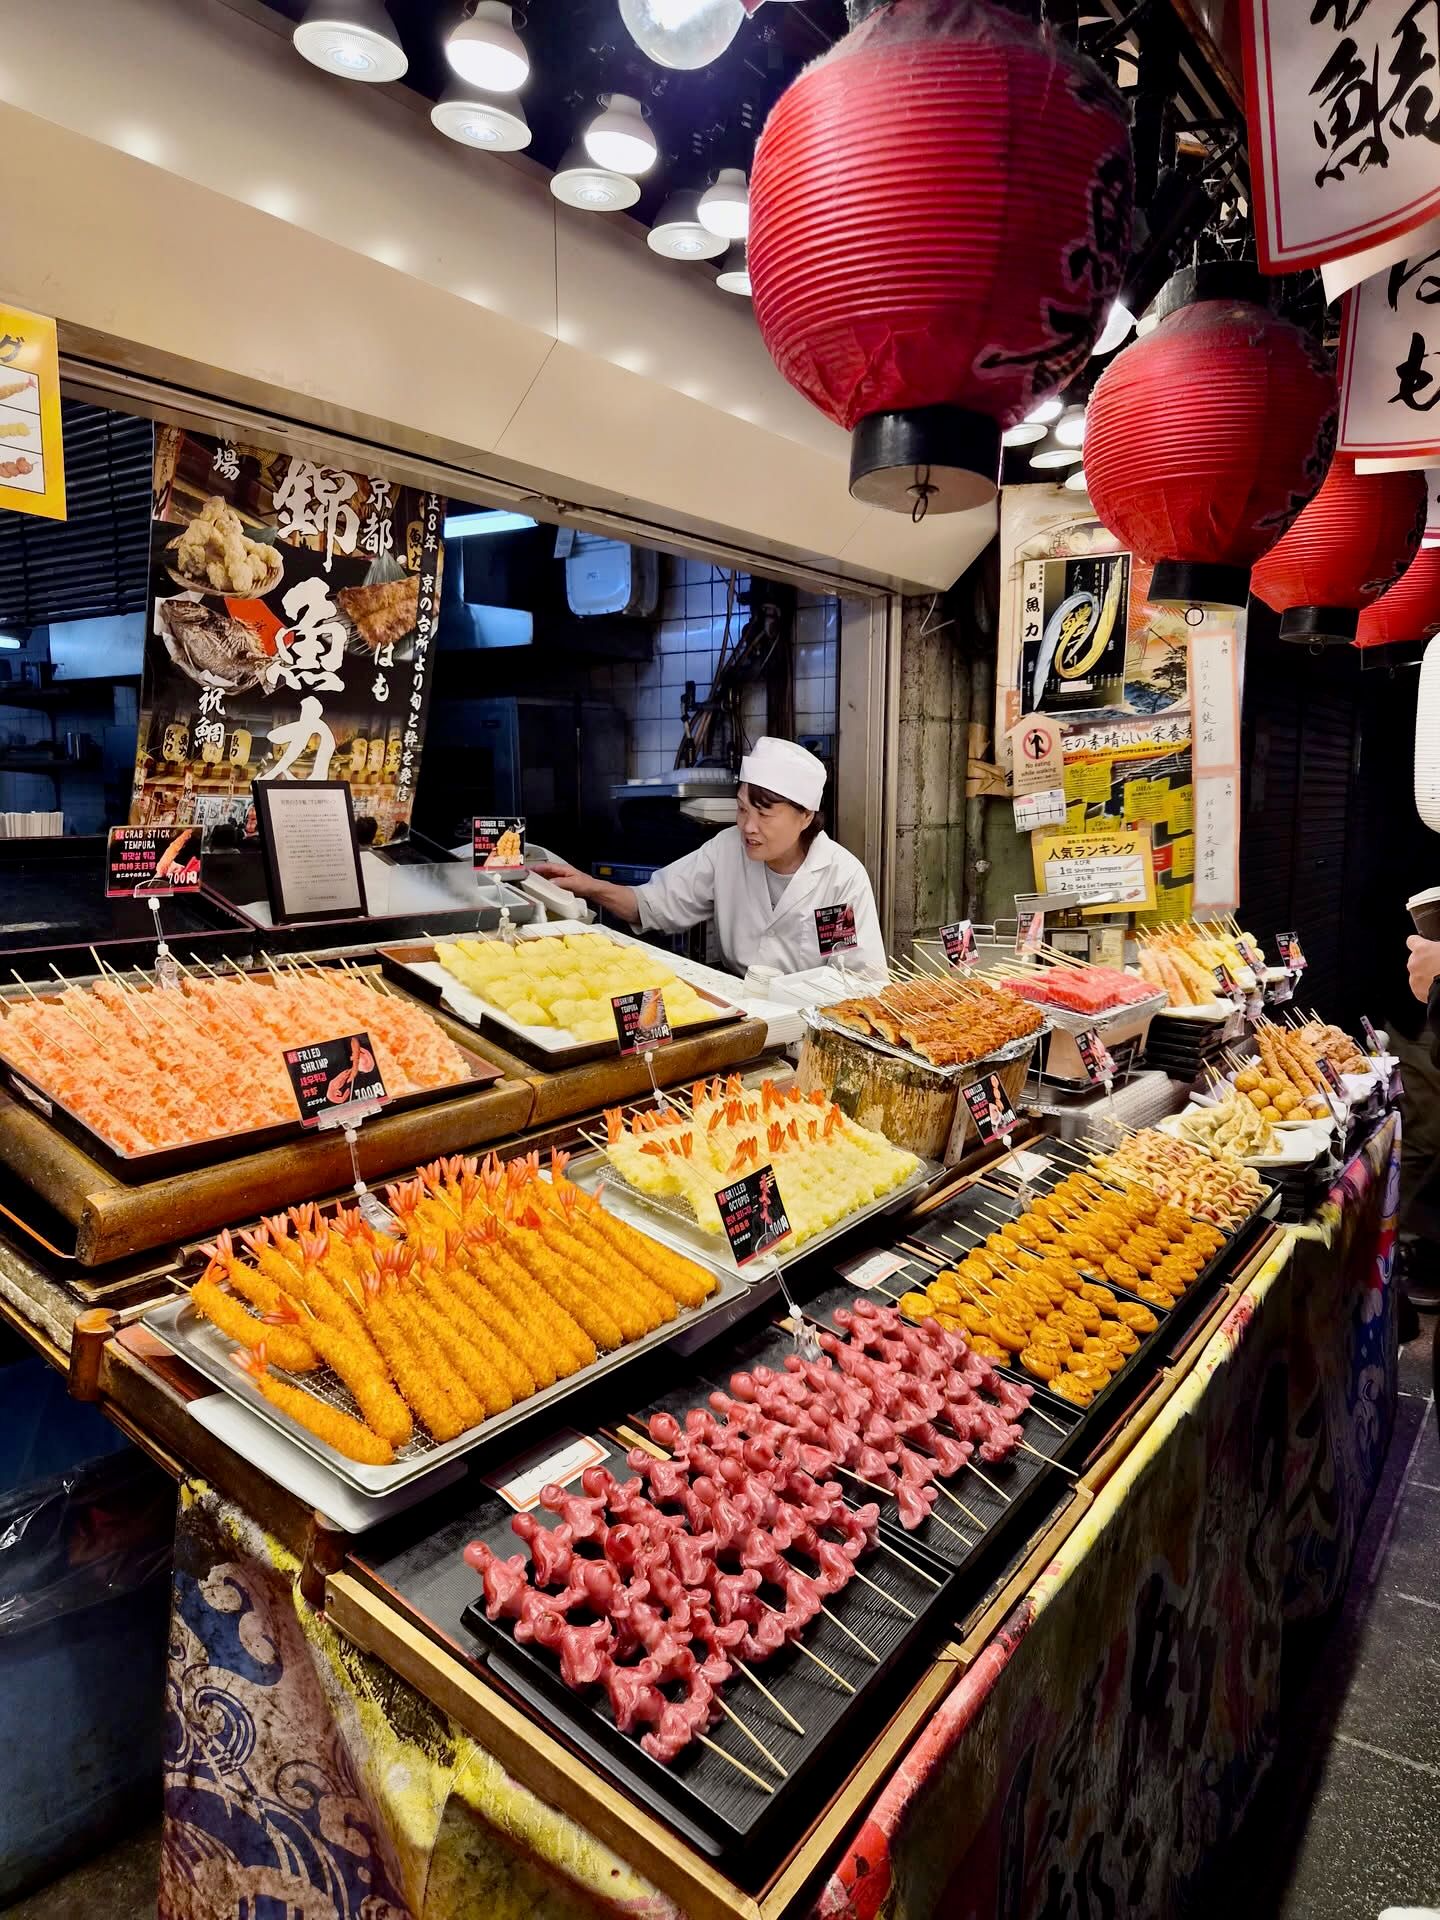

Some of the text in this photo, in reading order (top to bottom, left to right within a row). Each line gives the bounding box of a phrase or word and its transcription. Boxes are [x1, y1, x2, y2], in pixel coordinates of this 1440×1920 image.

[371, 642, 396, 702] はも
[193, 686, 226, 748] 祝鯛
[1021, 766, 1057, 777] while walking
[1035, 760, 1051, 768] eating
[124, 829, 144, 839] CRAB
[147, 829, 170, 839] STICK
[124, 840, 156, 850] TEMPURA
[1048, 841, 1137, 861] 人気ランキング
[1096, 865, 1122, 873] Tempura
[168, 871, 197, 884] 700円
[1095, 881, 1123, 889] Tempura
[297, 1047, 321, 1062] FRIED
[300, 1058, 329, 1074] SHRIMP
[354, 1082, 384, 1101] 700円
[725, 1182, 747, 1201] GRILLED
[728, 1193, 751, 1212] OCTOPUS
[769, 1214, 790, 1236] 700円
